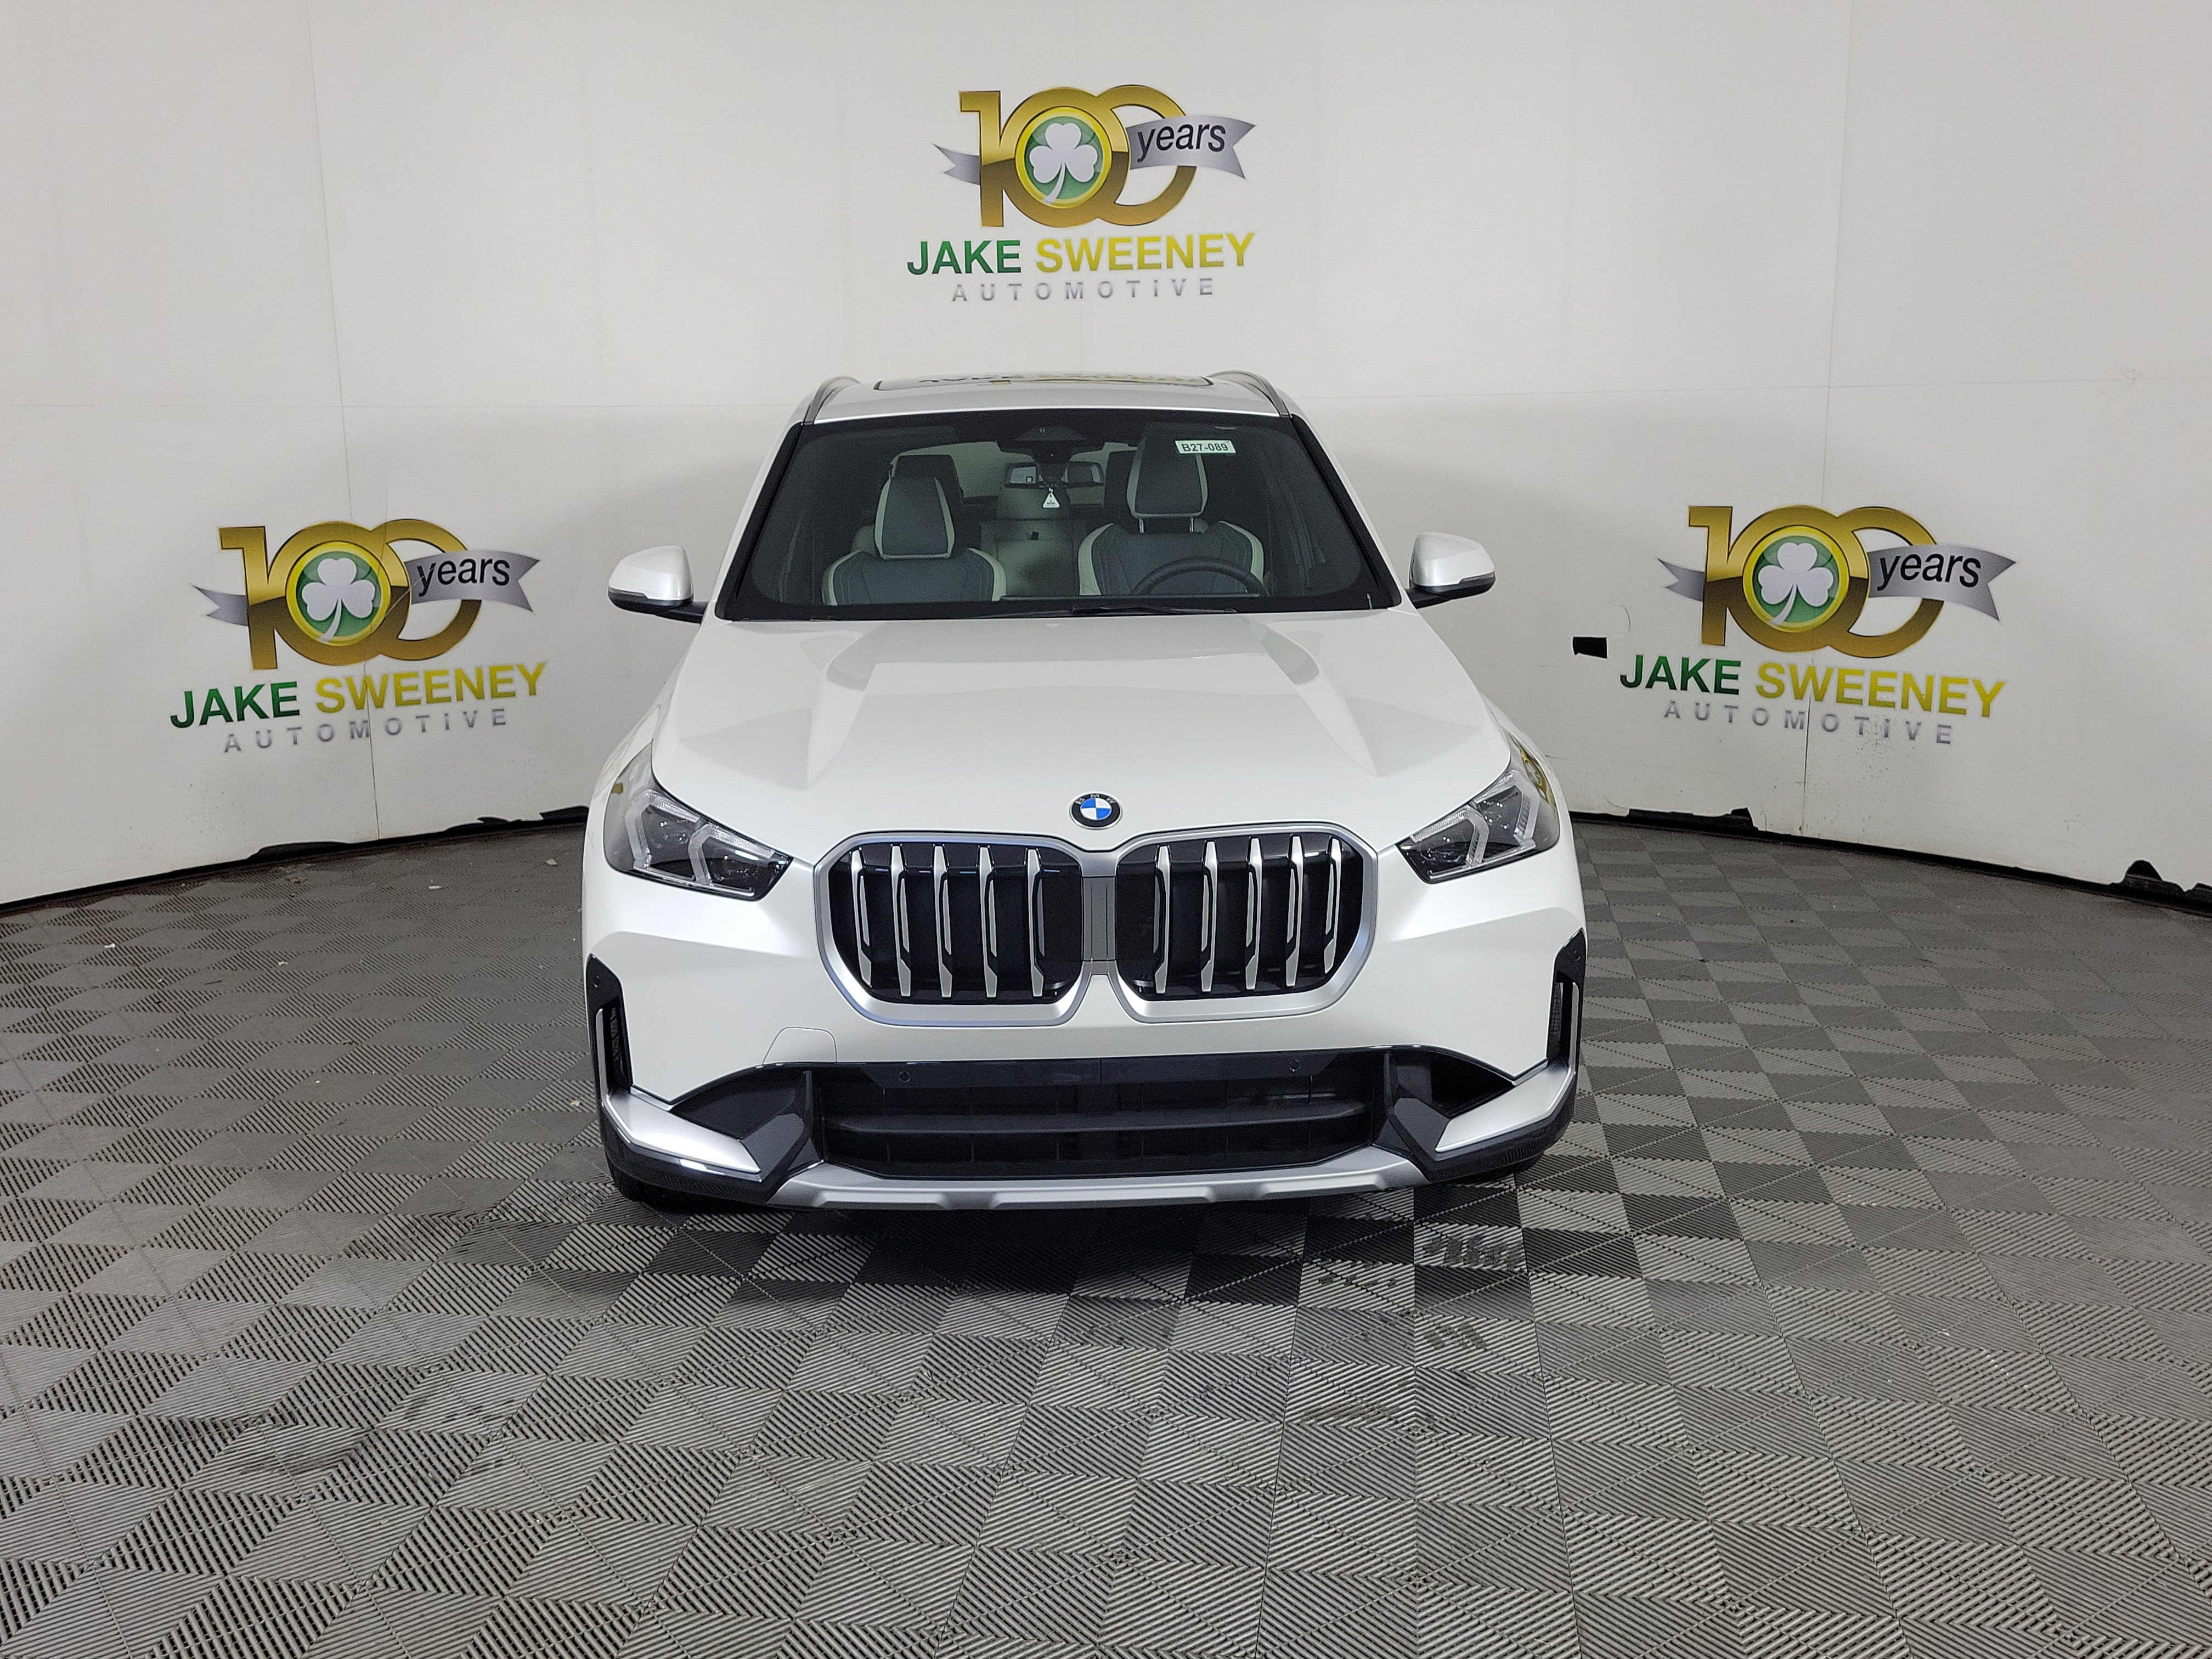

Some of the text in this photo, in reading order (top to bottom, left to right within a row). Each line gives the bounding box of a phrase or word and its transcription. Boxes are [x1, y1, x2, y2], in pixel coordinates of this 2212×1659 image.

[958, 84, 1198, 228] 100
[1136, 122, 1227, 162] years
[907, 231, 1256, 275] JAKE SWEENEY
[952, 278, 1213, 302] AUTOMOTIVE
[1181, 443, 1228, 452] B27-089
[416, 556, 511, 597] years
[1687, 505, 1945, 658] 100
[1876, 552, 1982, 591] years
[218, 518, 483, 670] 100
[170, 662, 546, 729] JAKE SWEENEY
[1620, 654, 2006, 718] JAKE SWEENEY
[223, 708, 507, 754] AUTOMOTIVE
[1663, 700, 1953, 744] AUTOMOTIVE
[1075, 793, 1116, 805] BMW
